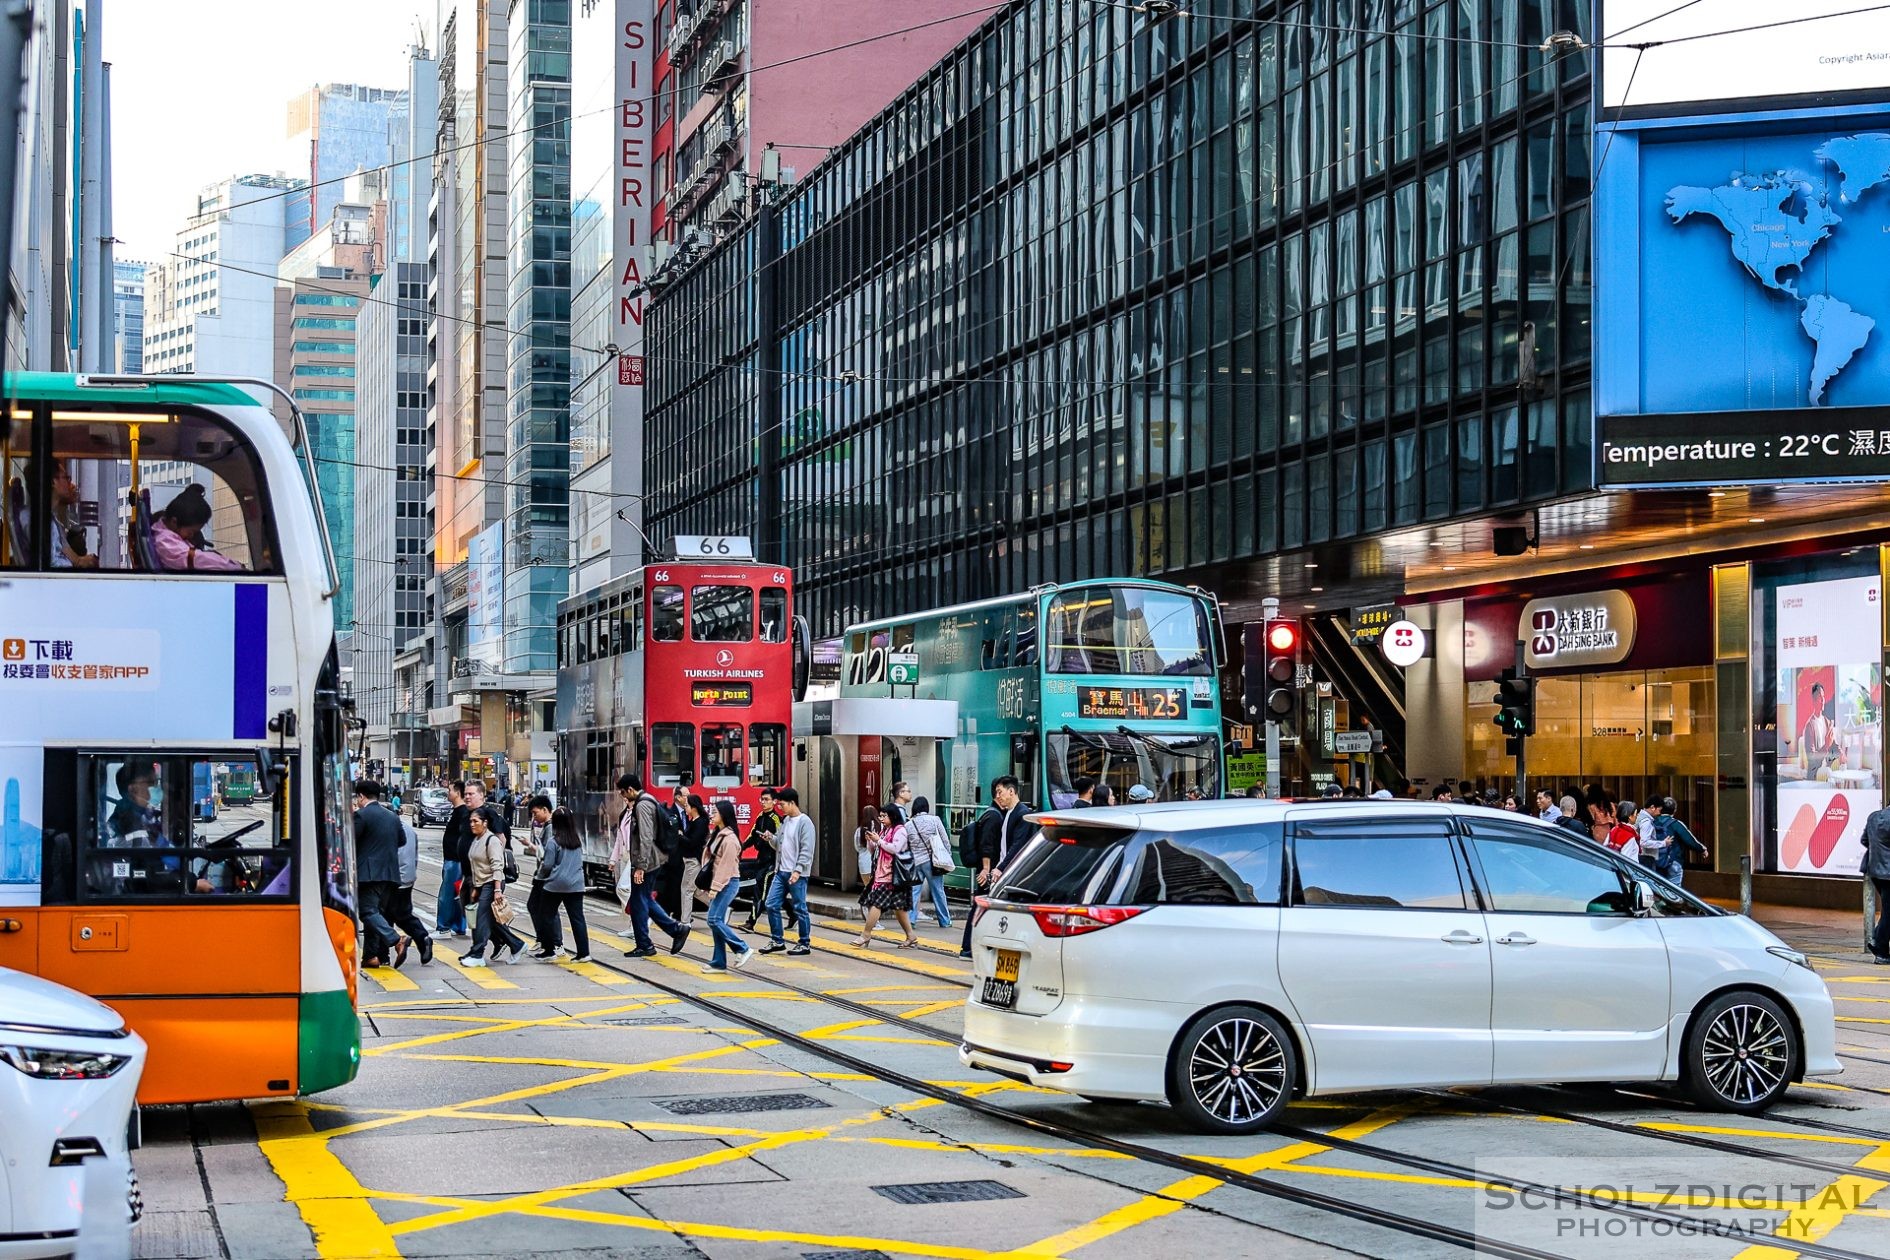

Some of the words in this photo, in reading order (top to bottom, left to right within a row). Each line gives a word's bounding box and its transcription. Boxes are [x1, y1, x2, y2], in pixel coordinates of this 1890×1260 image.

[1819, 54, 1863, 64] Copyright
[1866, 53, 1890, 61] Asiar
[620, 22, 644, 325] SIBERIAN
[1752, 224, 1785, 232] Chicago
[1792, 239, 1810, 247] York
[1779, 434, 1839, 457] 22°C
[700, 538, 730, 554] 66
[655, 570, 669, 582] 66
[773, 572, 785, 584] 66
[1559, 608, 1606, 632] 大新銀行
[1559, 636, 1573, 649] DAH
[1575, 634, 1591, 648] SING
[1593, 632, 1615, 647] BANK
[29, 640, 73, 660] 下載
[3, 664, 149, 679] 投委會收支管家APP
[684, 669, 724, 678] TURKISH
[726, 669, 764, 678] AIRLINES
[693, 690, 719, 700] North
[723, 690, 748, 699] Point
[1089, 690, 1142, 706] 寶馬山
[1133, 706, 1148, 716] Hill
[1152, 692, 1180, 717] 25
[1005, 957, 1018, 975] 869
